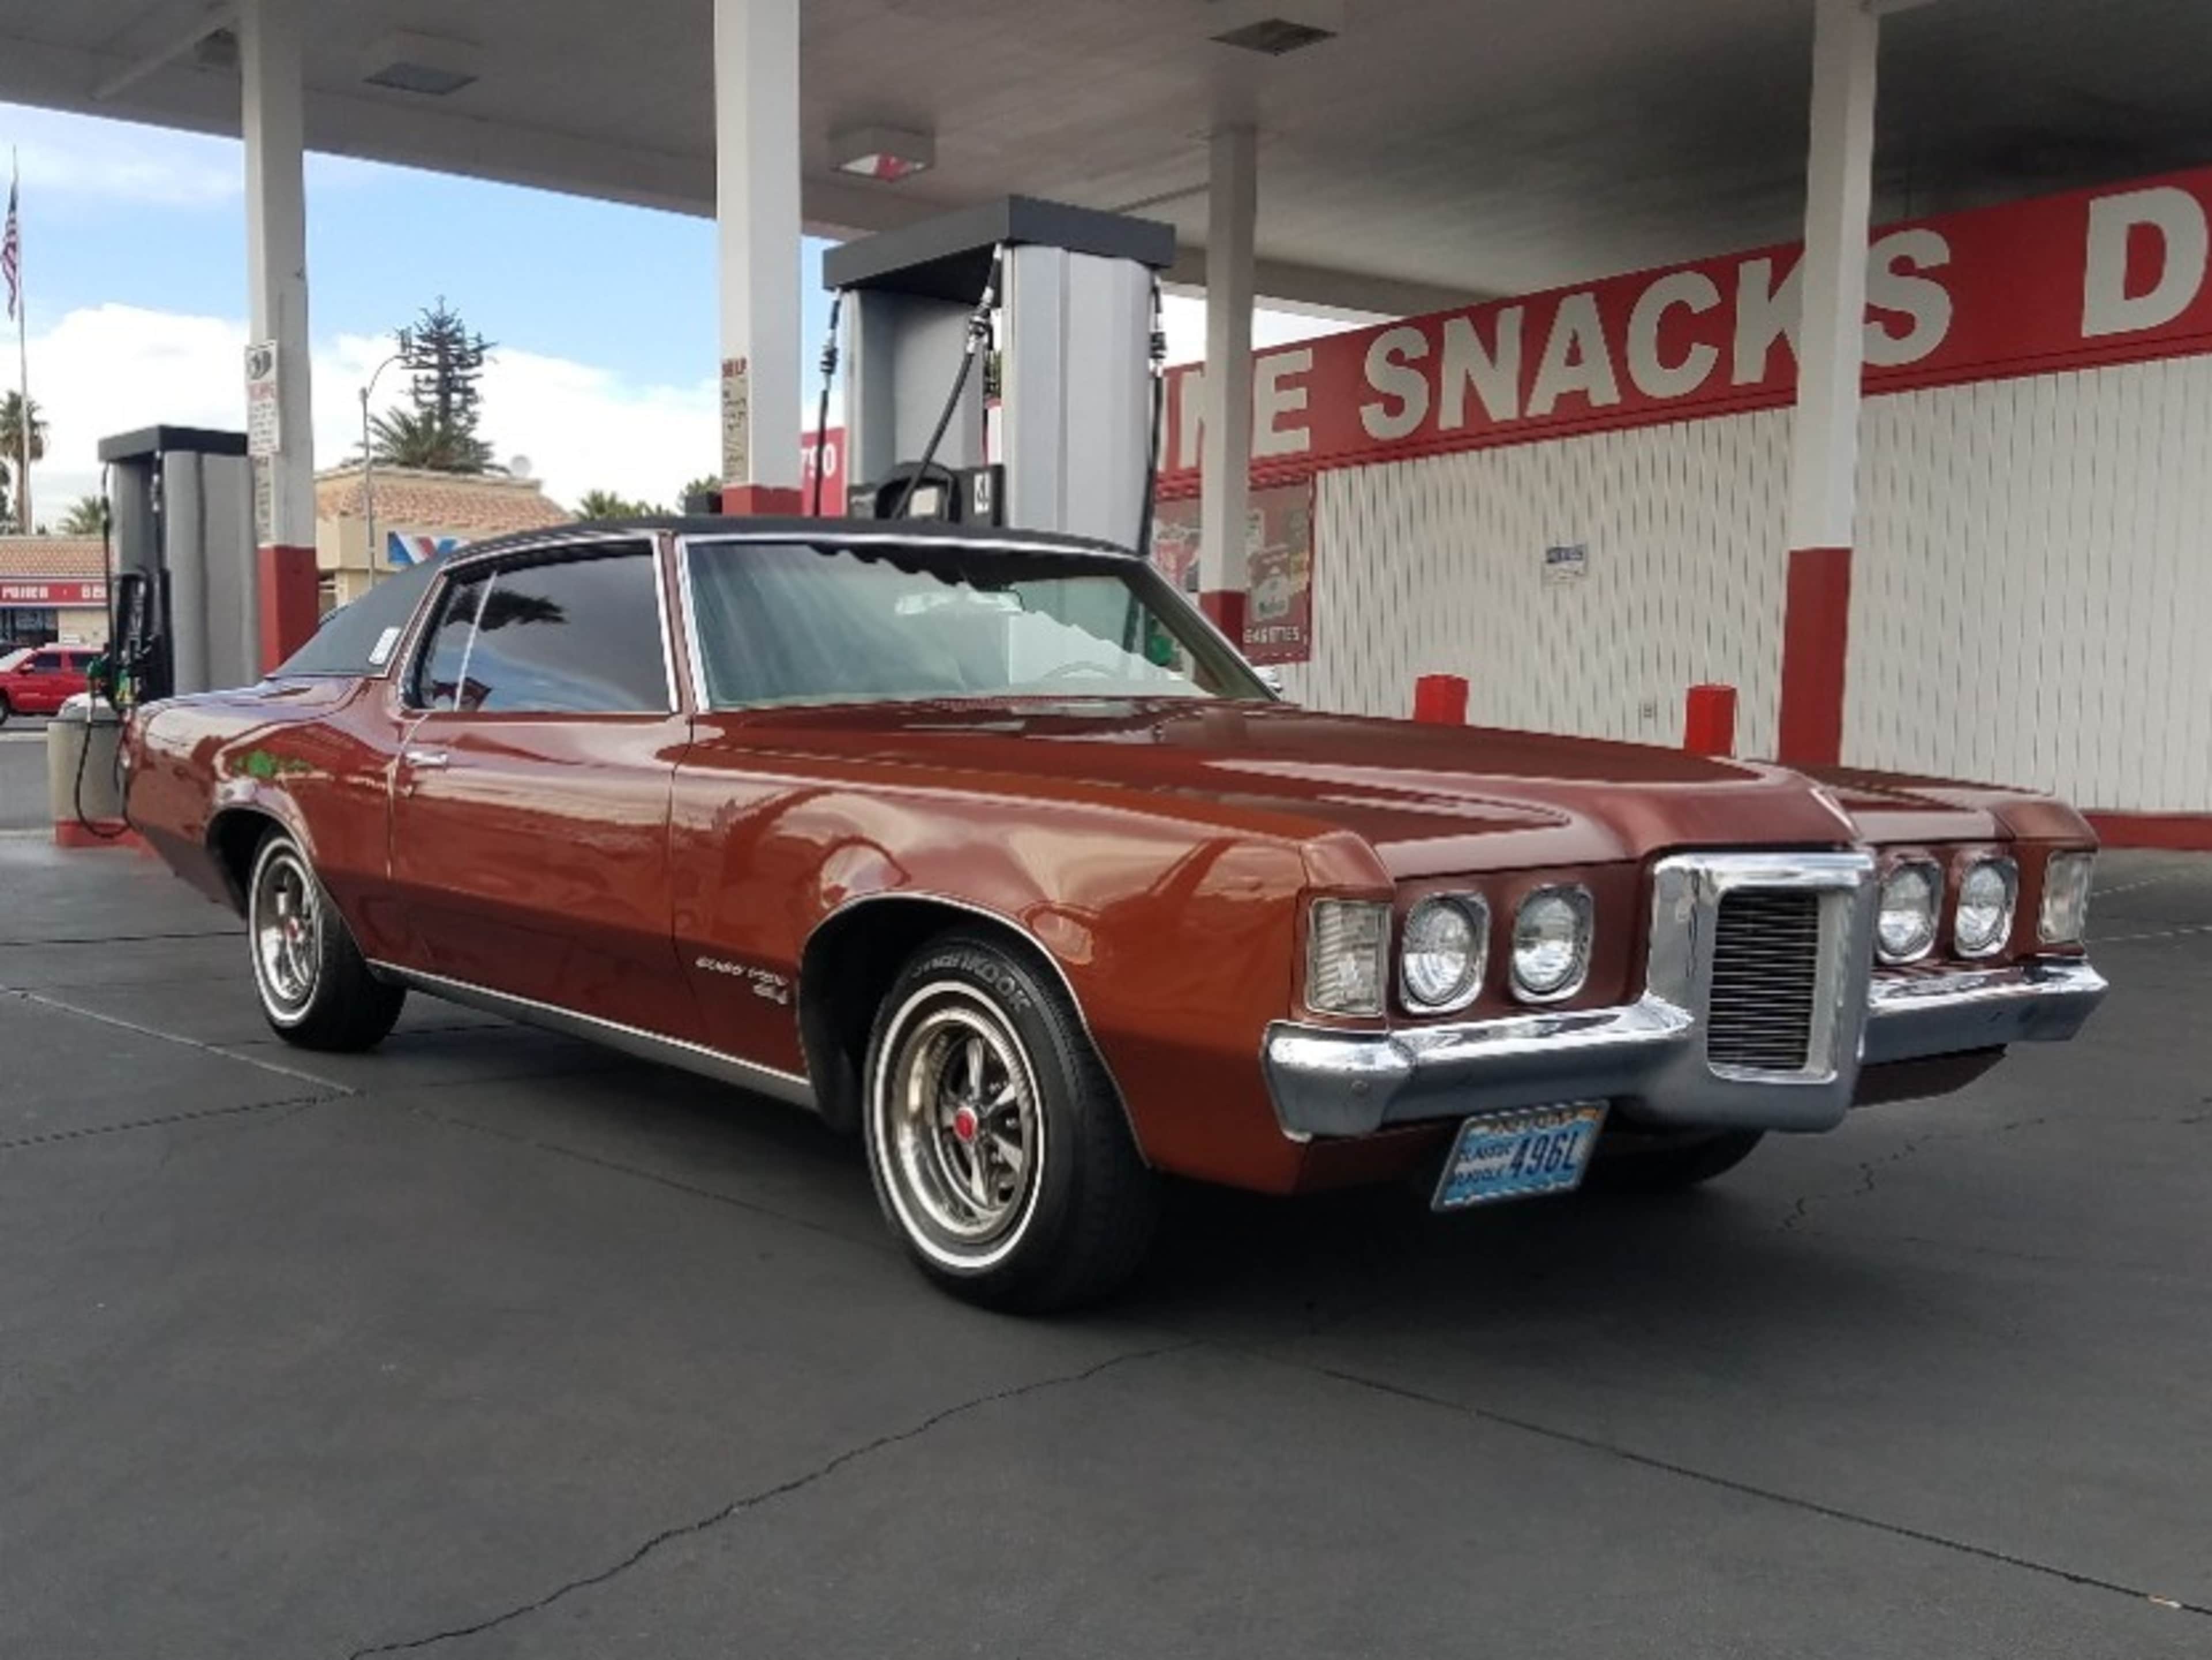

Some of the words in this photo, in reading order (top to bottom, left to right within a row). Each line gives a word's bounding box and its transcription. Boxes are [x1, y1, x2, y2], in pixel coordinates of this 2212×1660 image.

[1359, 229, 1953, 441] SNACKS
[2081, 188, 2209, 338] D
[1508, 1130, 1579, 1179] 496L
